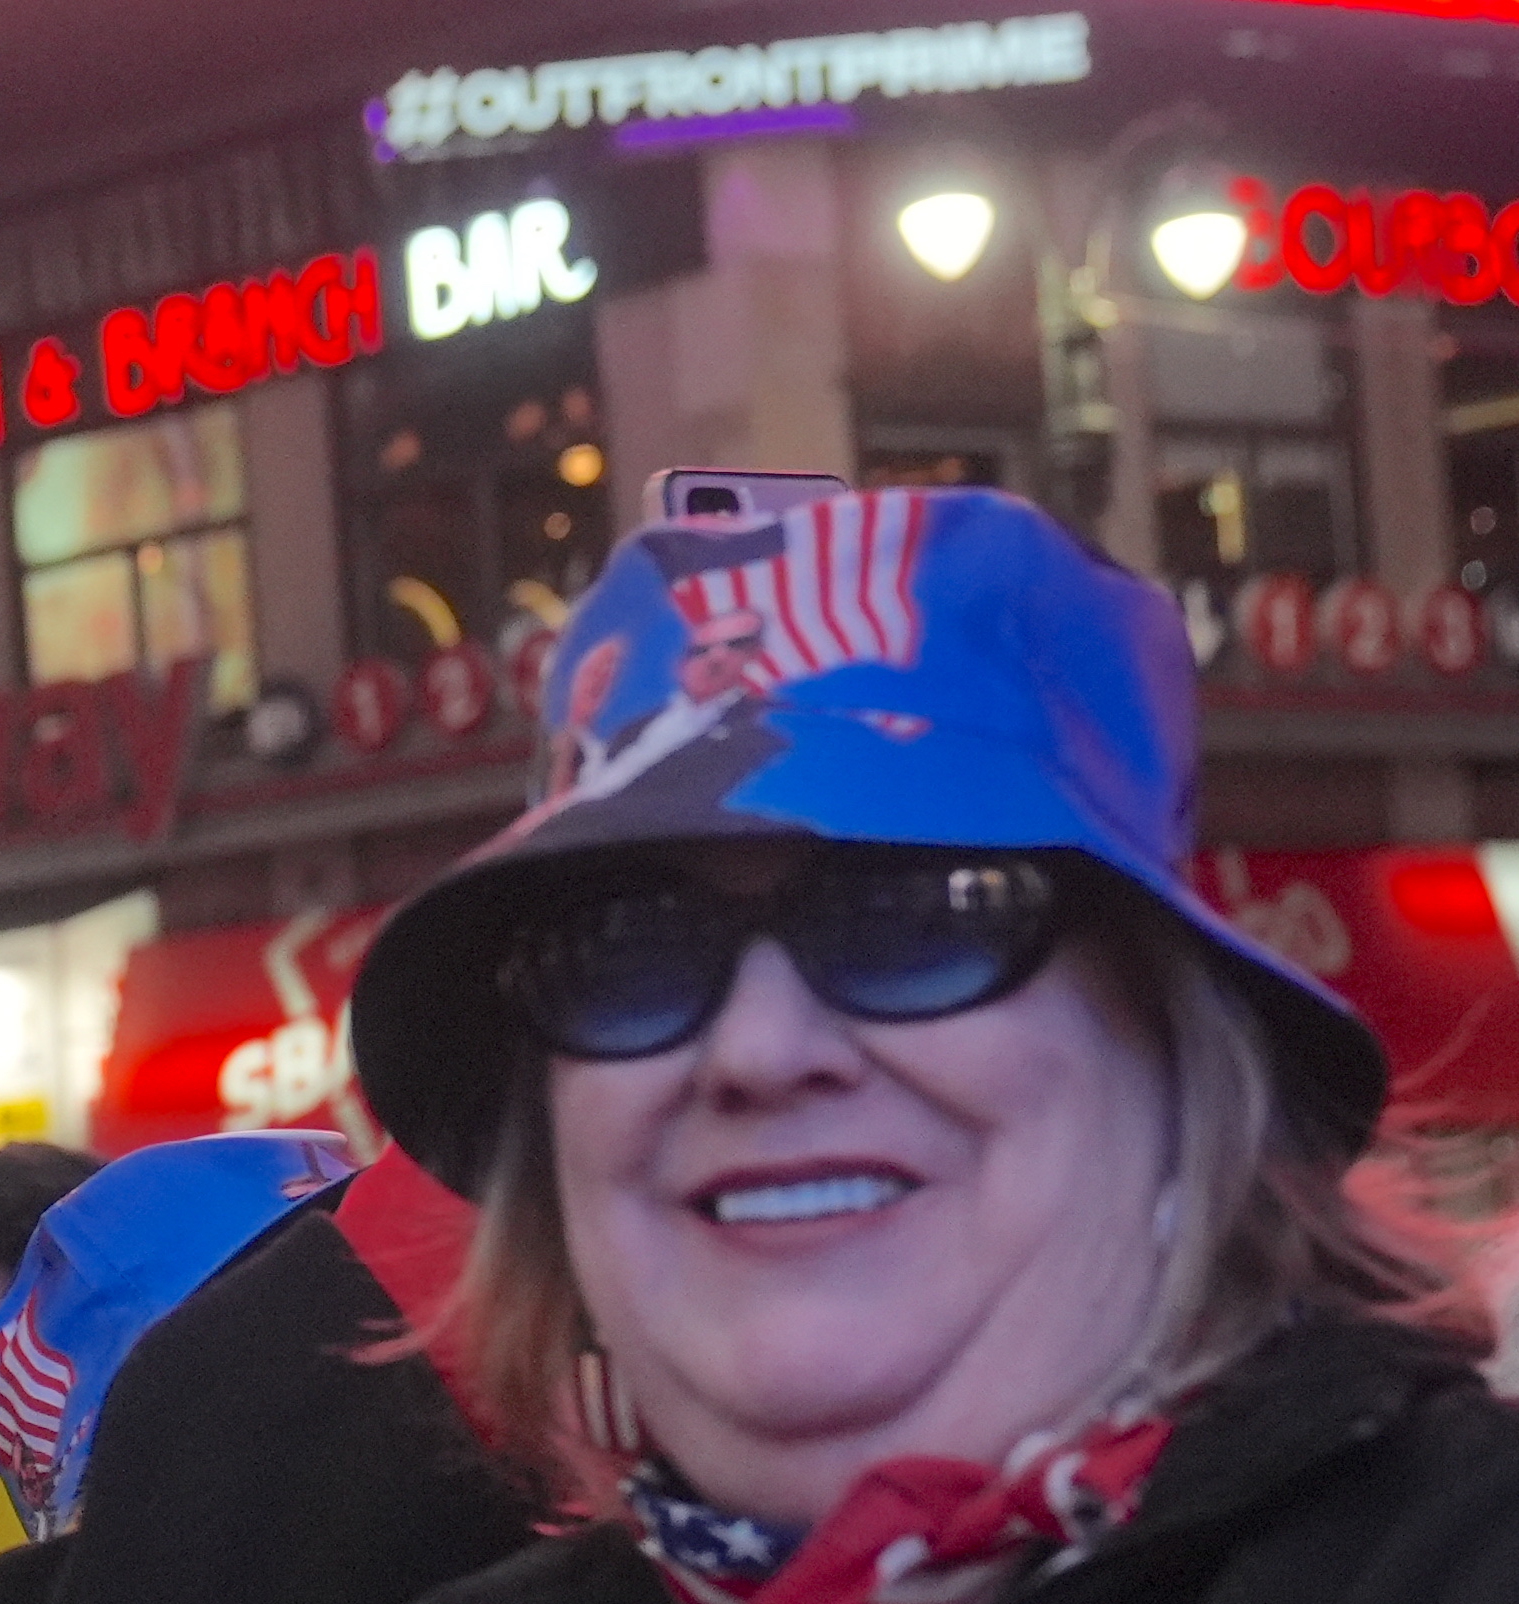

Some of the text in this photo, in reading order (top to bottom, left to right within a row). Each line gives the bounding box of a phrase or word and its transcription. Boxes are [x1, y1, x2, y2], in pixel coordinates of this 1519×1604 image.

[24, 337, 80, 427] &
[102, 248, 381, 417] BRANCH
[407, 198, 597, 340] BAR
